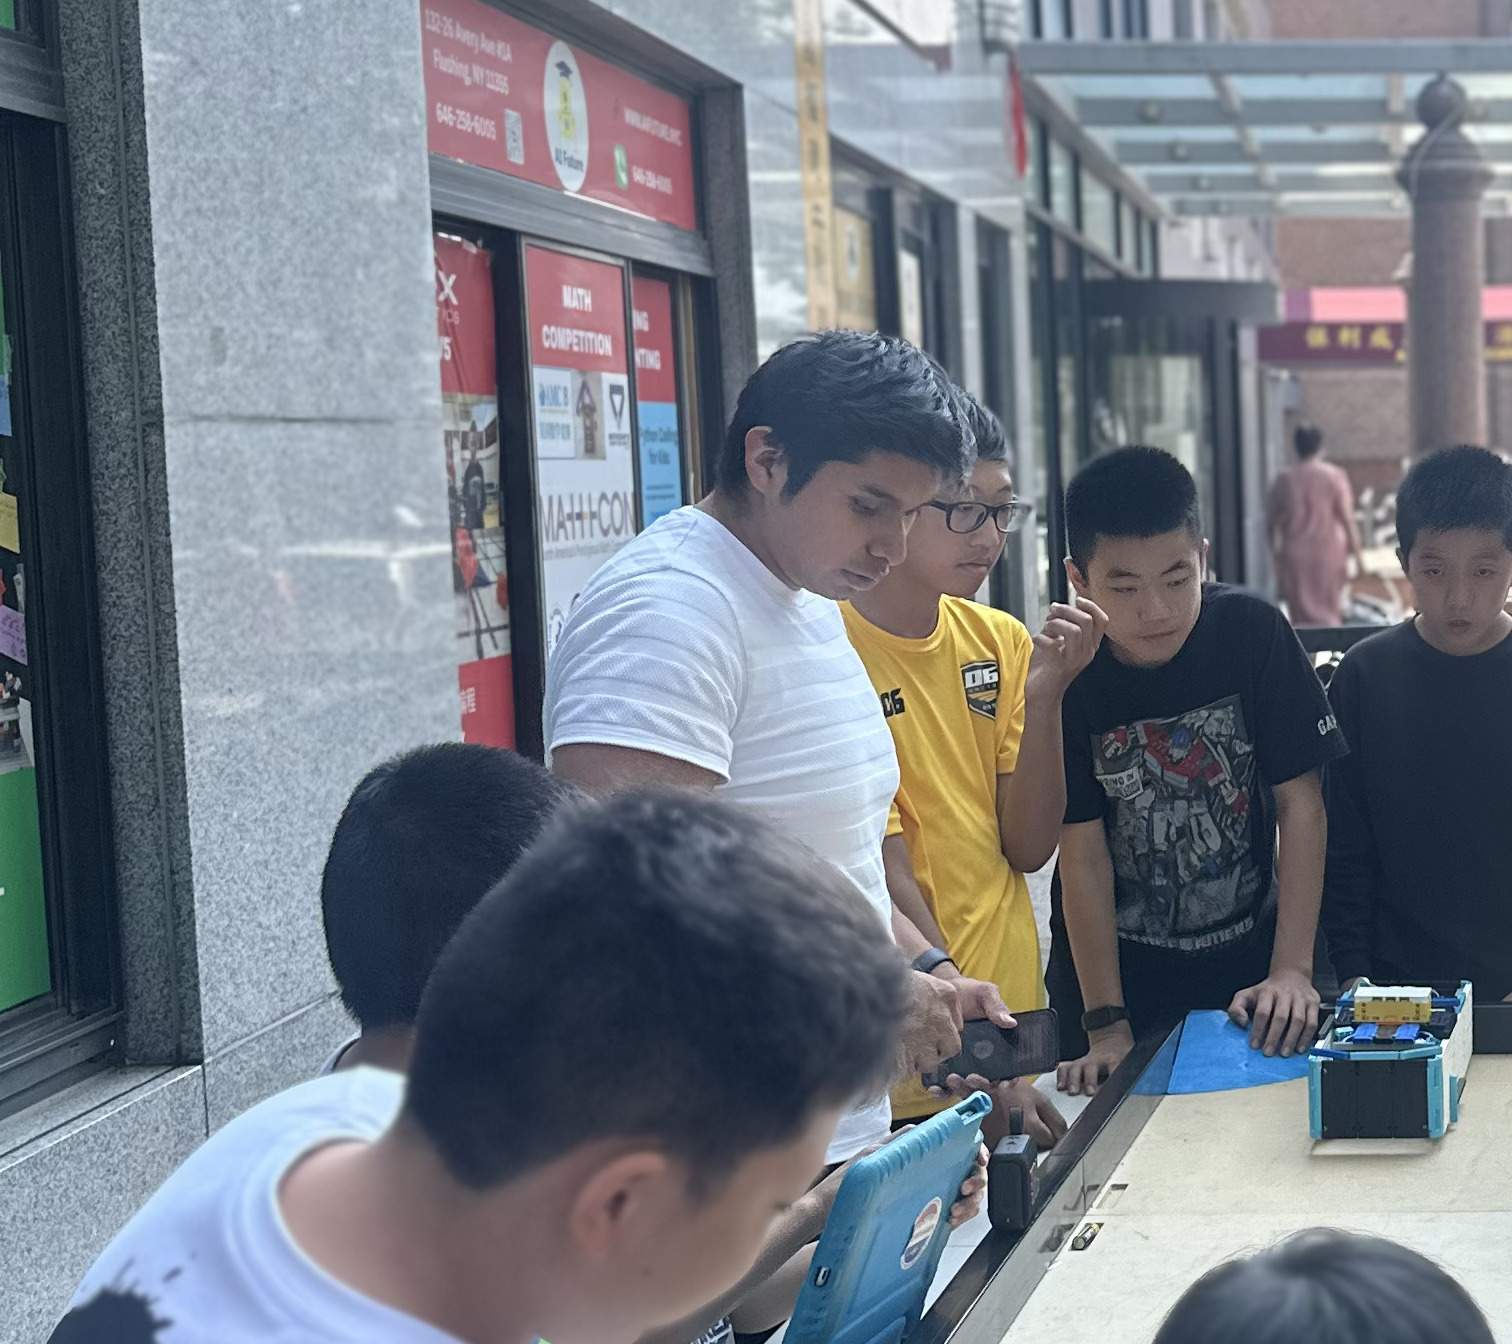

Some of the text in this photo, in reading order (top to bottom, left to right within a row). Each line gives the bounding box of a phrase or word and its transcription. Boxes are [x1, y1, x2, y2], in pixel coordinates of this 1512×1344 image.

[455, 21, 479, 55] Avery
[472, 63, 485, 86] NY
[562, 284, 592, 312] MATH
[542, 324, 612, 356] COMPETITION
